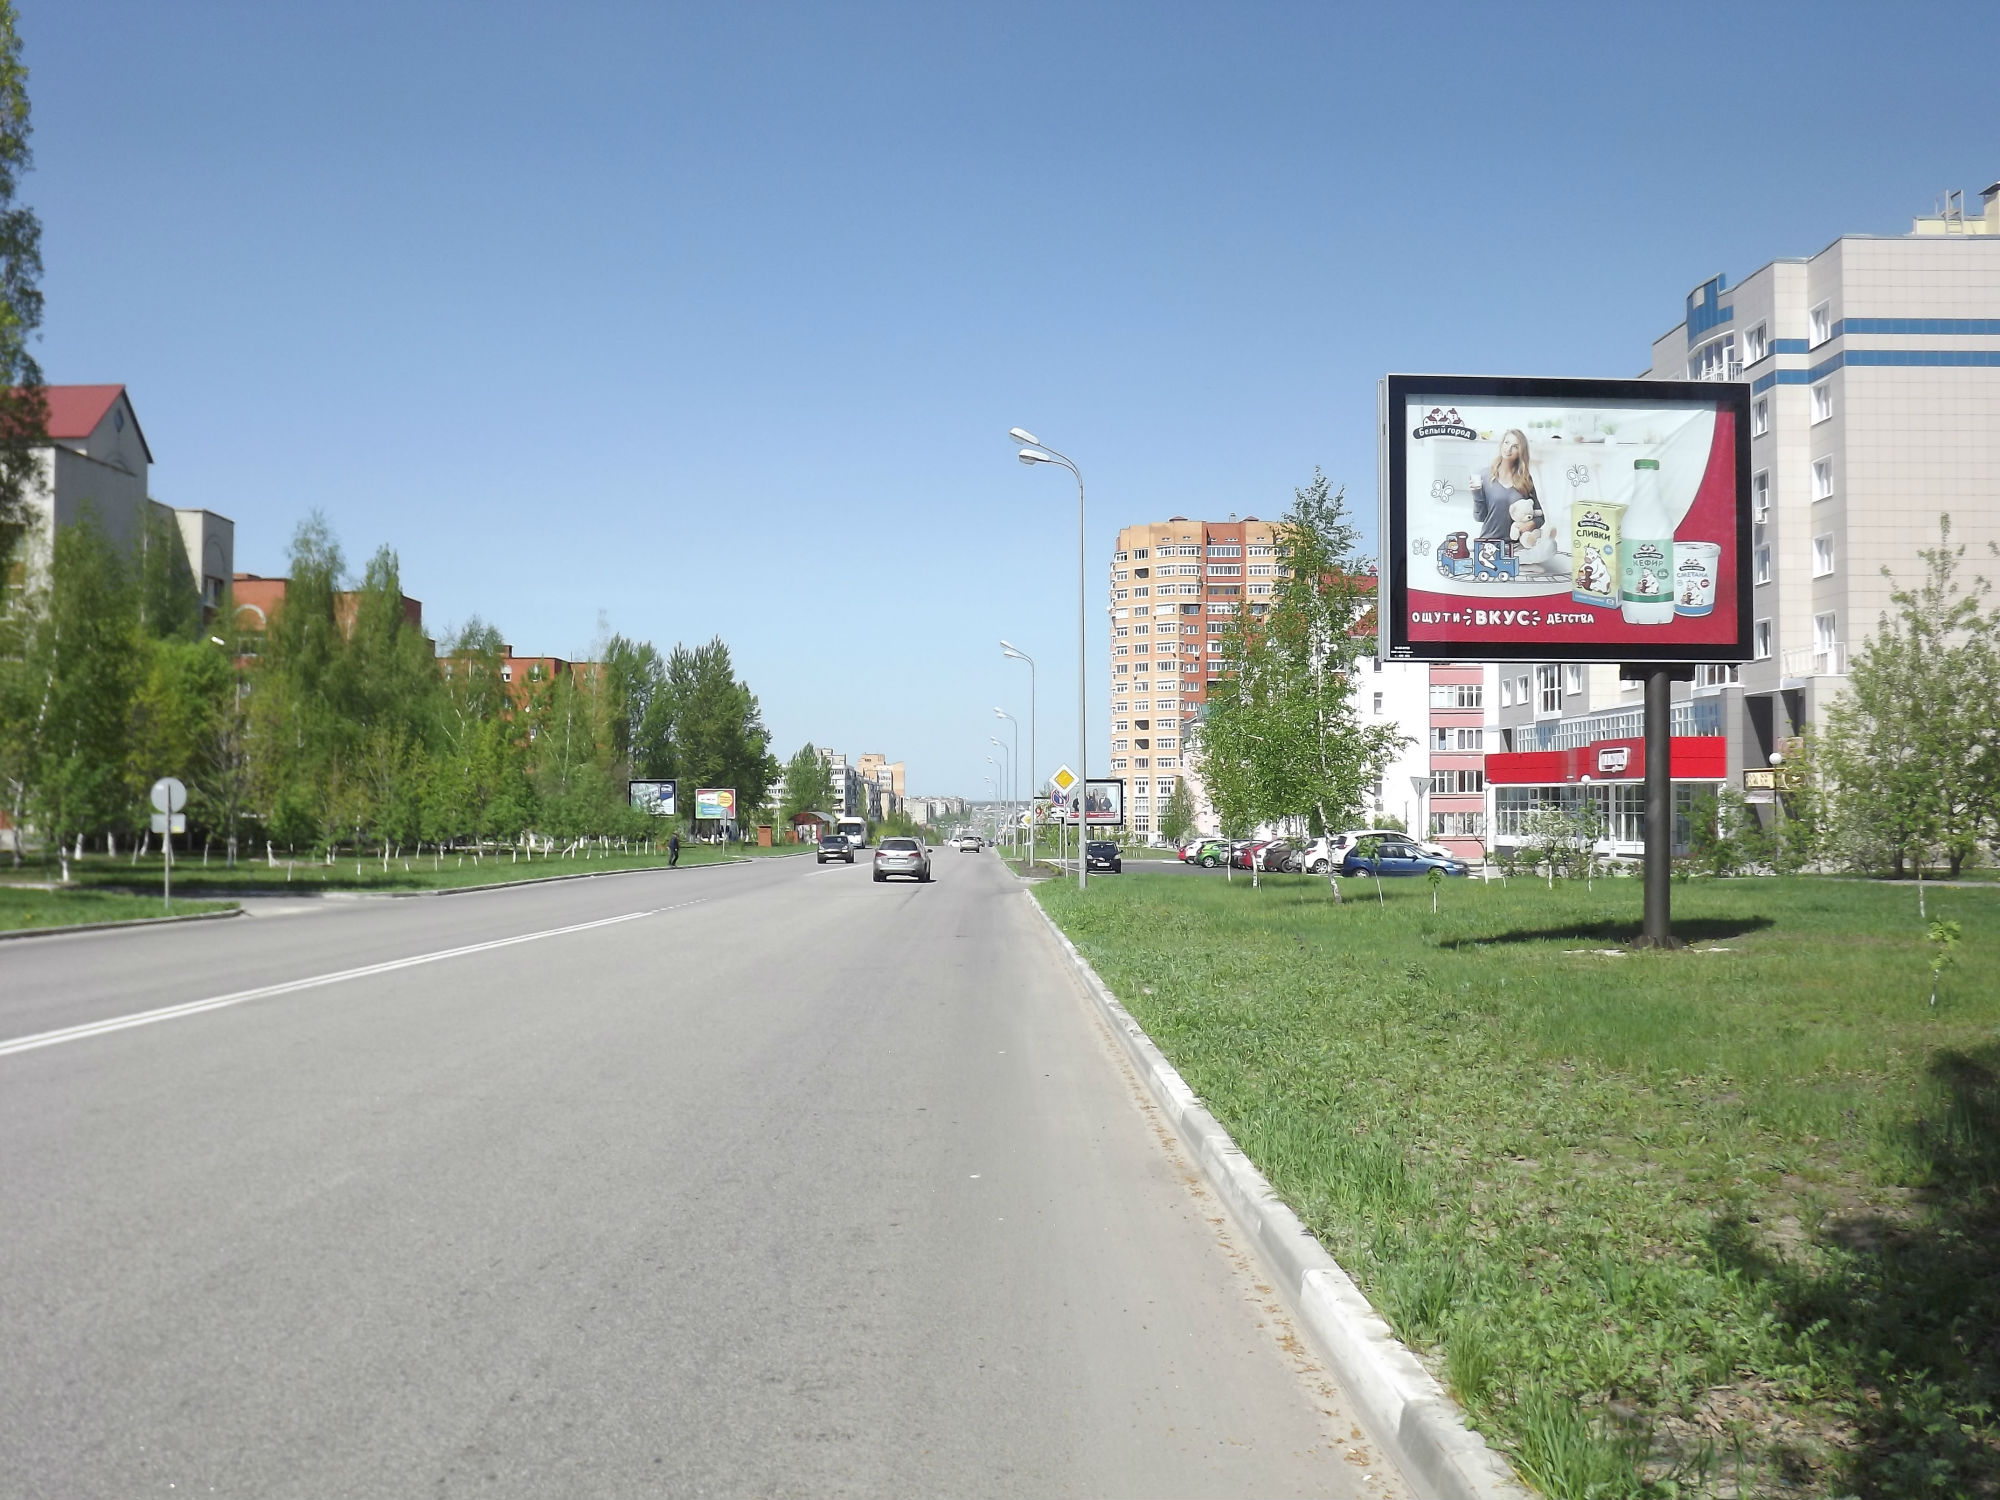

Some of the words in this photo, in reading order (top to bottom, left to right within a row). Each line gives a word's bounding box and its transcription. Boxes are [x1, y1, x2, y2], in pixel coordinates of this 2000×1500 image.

[1418, 425, 1446, 437] Белый
[1447, 427, 1471, 439] город
[1576, 529, 1611, 541] СЛИВКИ
[1632, 559, 1664, 567] КЕФИР
[1411, 611, 1461, 624] ОЩУТИ
[1474, 609, 1531, 626] ВКУС
[1546, 612, 1595, 625] ДЕТСТВА
